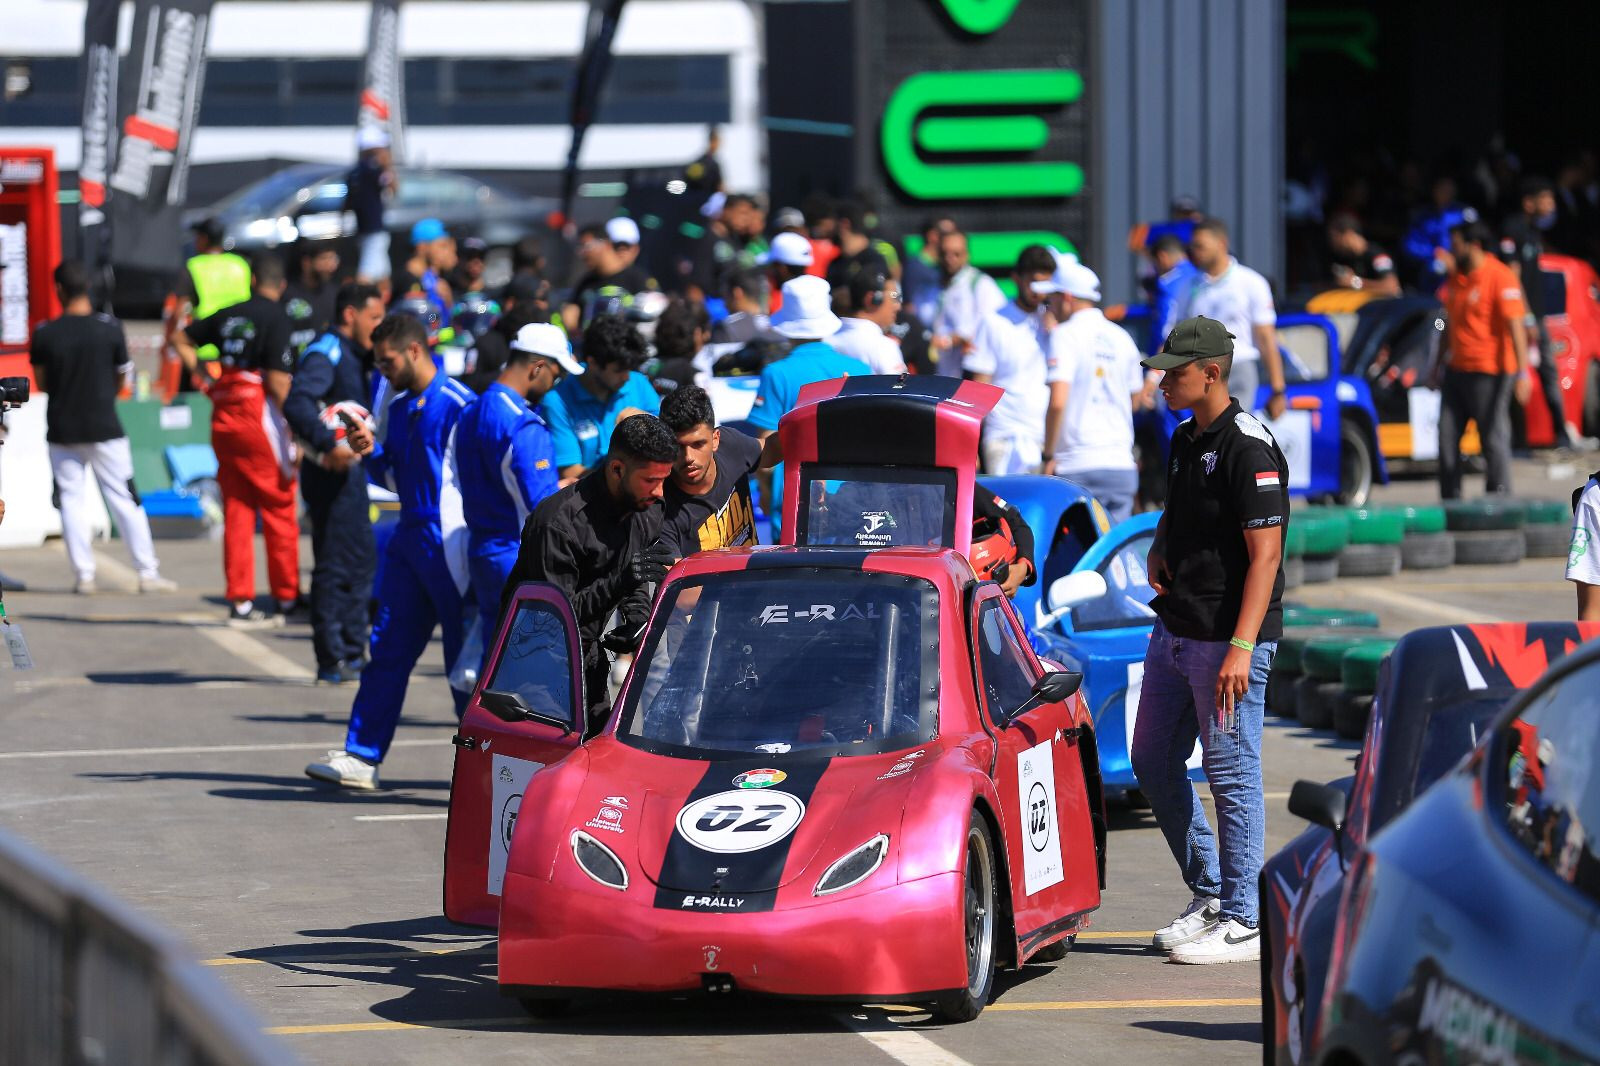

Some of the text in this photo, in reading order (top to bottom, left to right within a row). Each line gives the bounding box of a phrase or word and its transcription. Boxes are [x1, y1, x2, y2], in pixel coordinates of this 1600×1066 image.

[696, 804, 787, 833] 02
[1031, 799, 1046, 835] 02
[681, 895, 744, 909] E-RALLY
